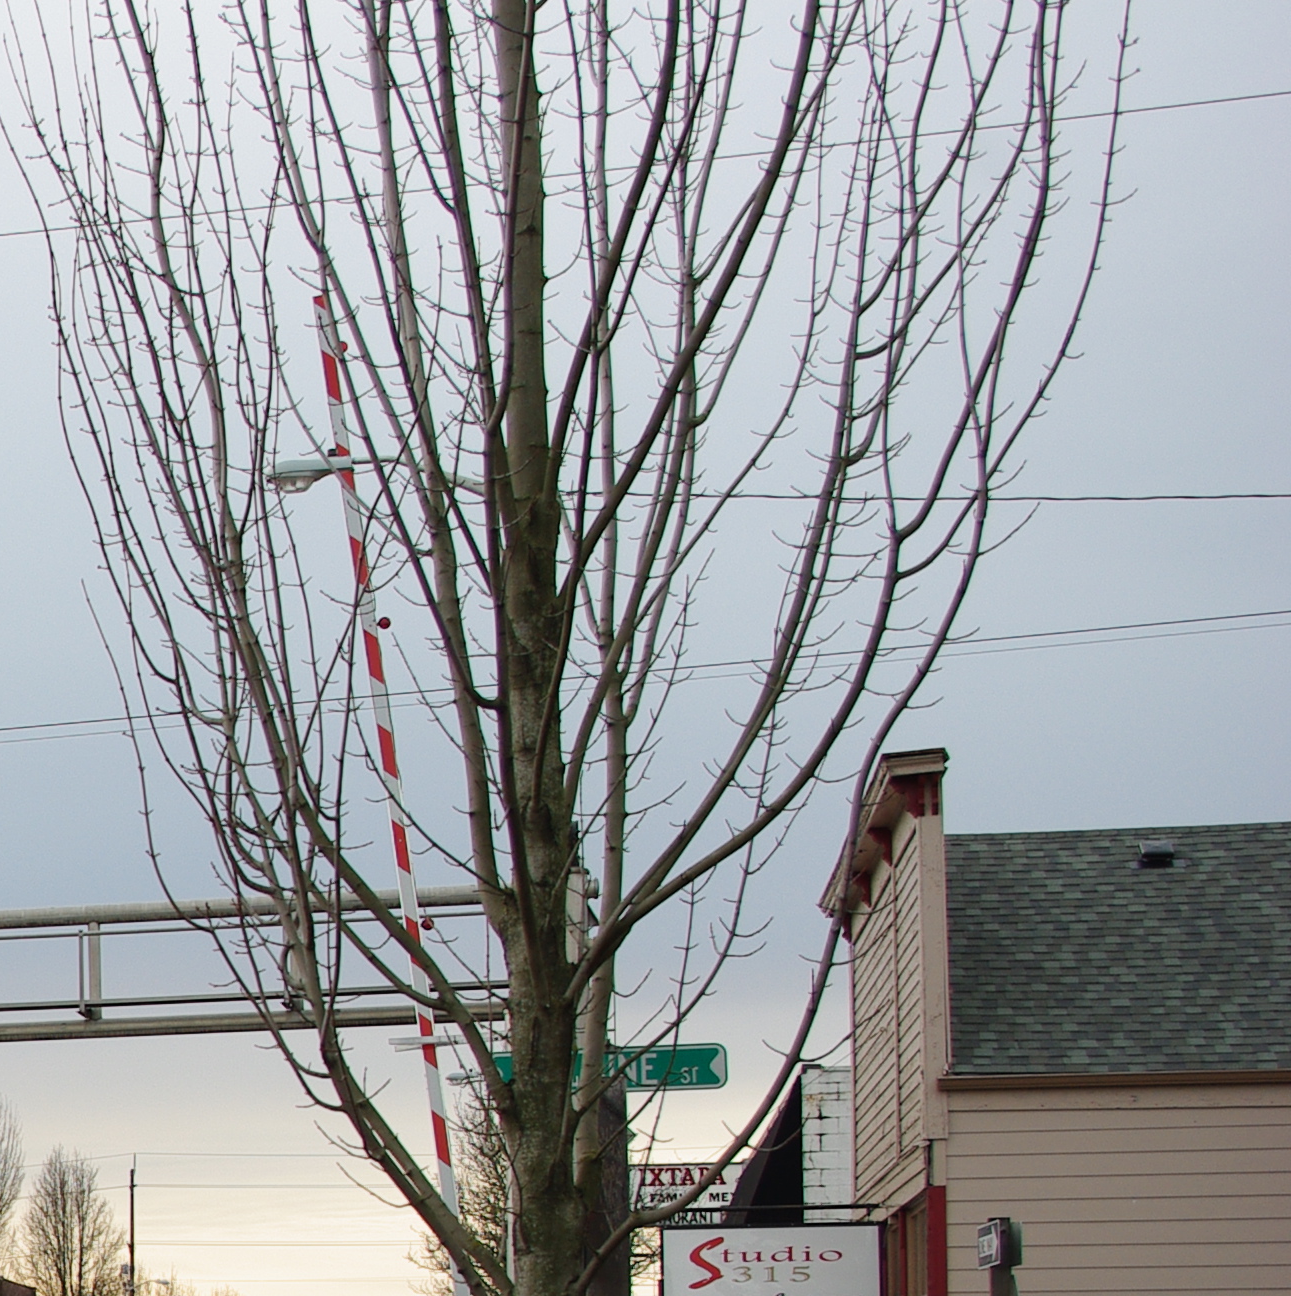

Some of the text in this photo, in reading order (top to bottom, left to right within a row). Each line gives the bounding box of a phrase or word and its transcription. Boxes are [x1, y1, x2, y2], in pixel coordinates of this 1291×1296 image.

[680, 1066, 699, 1085] ST
[688, 1236, 843, 1290] Studio
[731, 1265, 812, 1284] 315
